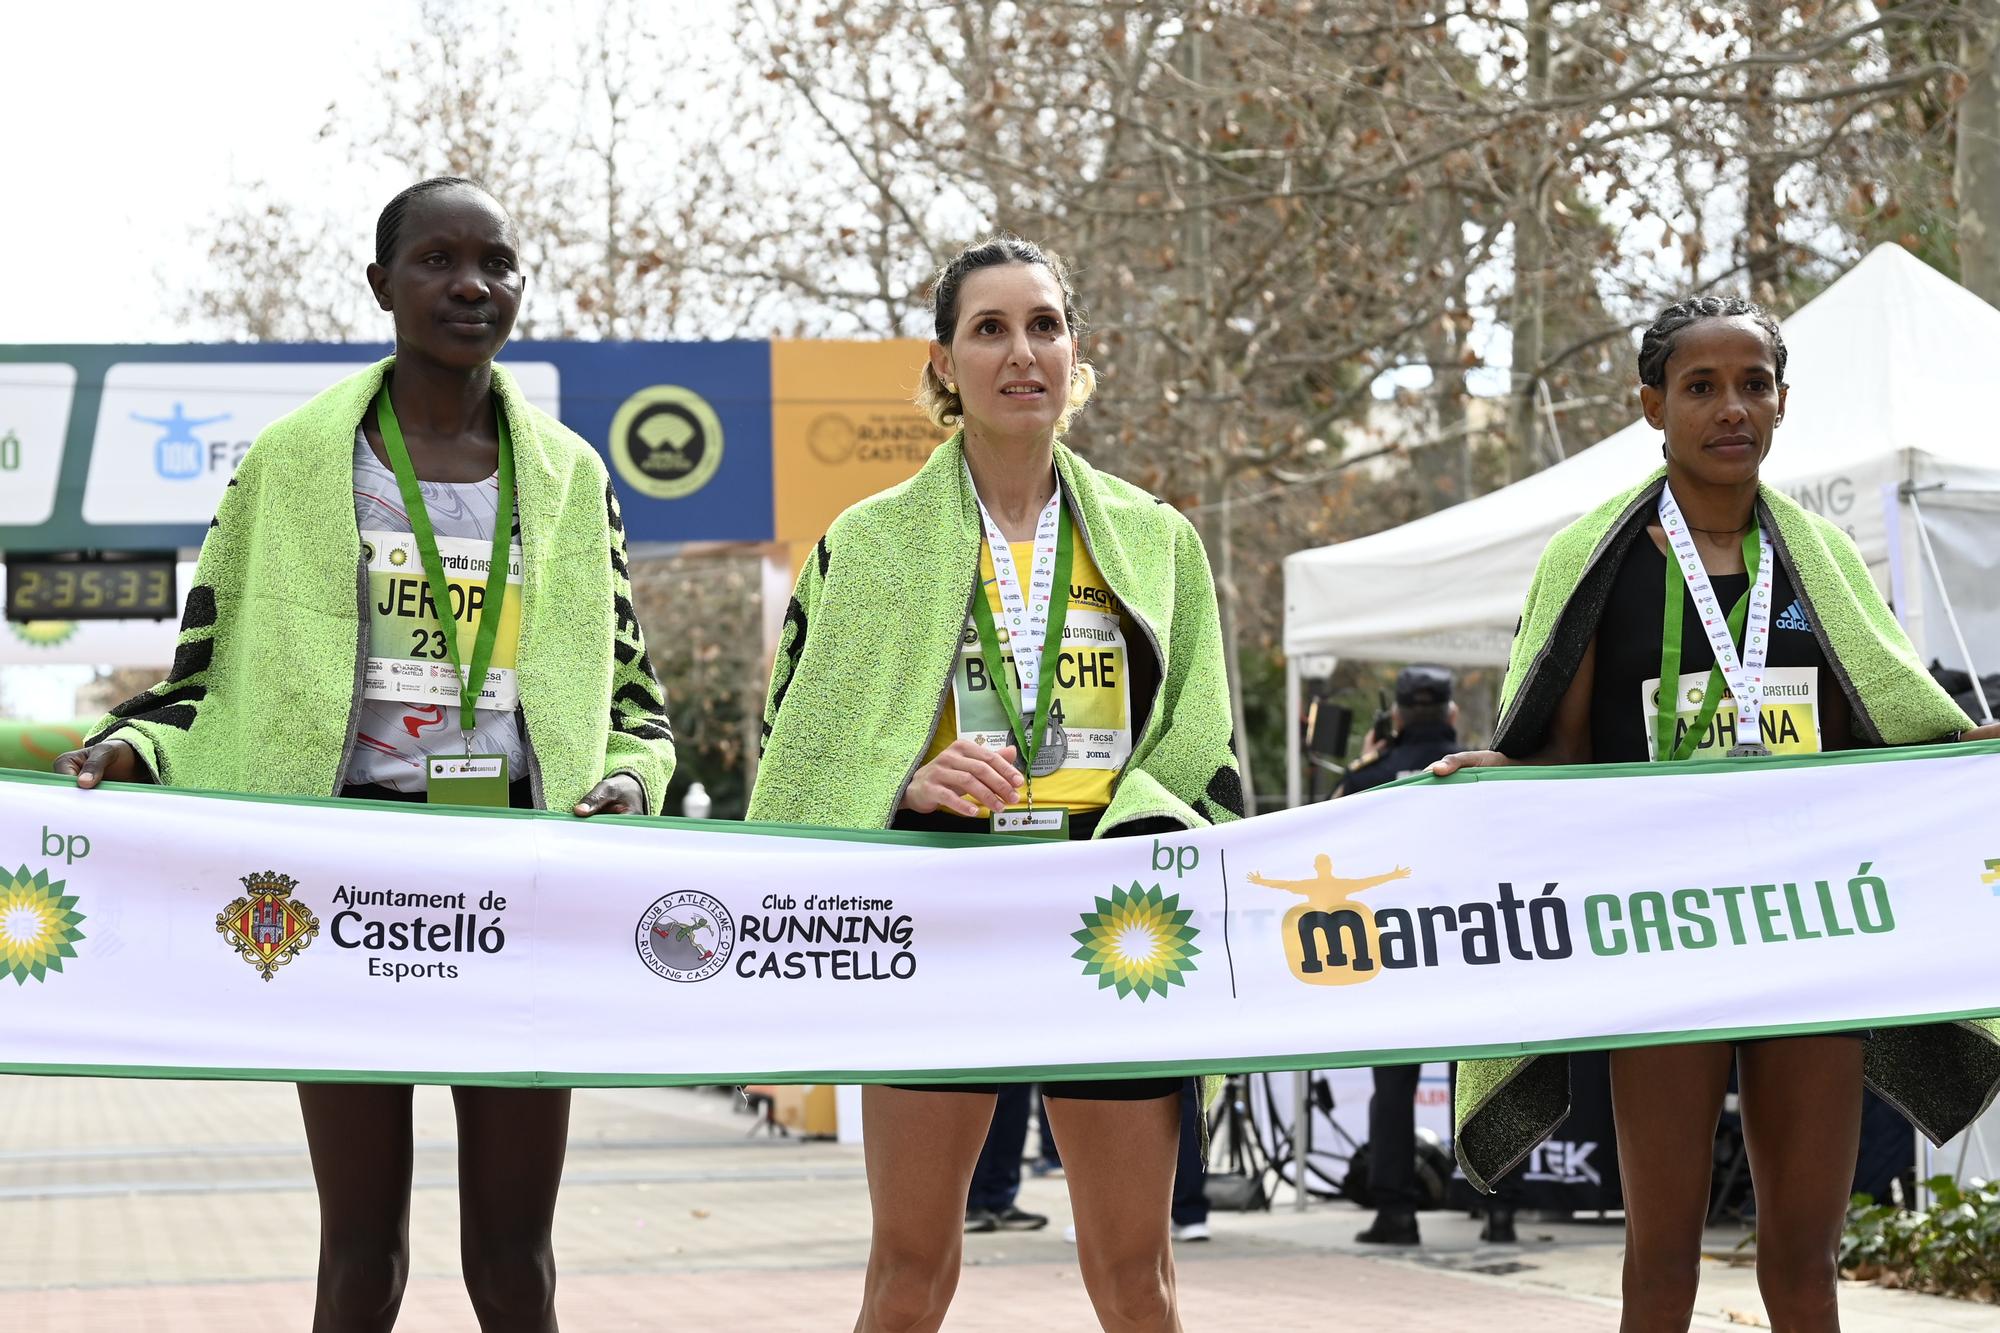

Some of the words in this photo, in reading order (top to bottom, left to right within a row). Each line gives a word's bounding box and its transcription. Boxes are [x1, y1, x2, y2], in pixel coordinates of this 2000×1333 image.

[14, 570, 170, 608] 2:35:33
[378, 578, 487, 622] JEROP
[410, 628, 448, 660] 23
[1073, 627, 1116, 642] CASTELLÓ
[1763, 682, 1809, 697] CASTELLÓ
[1089, 733, 1113, 742] Facsa
[42, 825, 91, 865] bp
[1151, 838, 1200, 879] bp
[332, 885, 466, 909] Ajuntament
[479, 890, 507, 911] de
[641, 906, 663, 931] CLUB
[678, 894, 732, 932] ATLETISME
[763, 894, 797, 911] Club
[804, 894, 893, 911] d'atletisme
[331, 911, 505, 954] Castelló
[740, 914, 914, 945] RUNNING
[1298, 883, 1573, 973] marató
[1585, 862, 1896, 956] CASTELLÓ
[368, 957, 459, 983] Esports
[640, 940, 682, 979] RUNNING
[735, 940, 917, 980] CASTELLÓ
